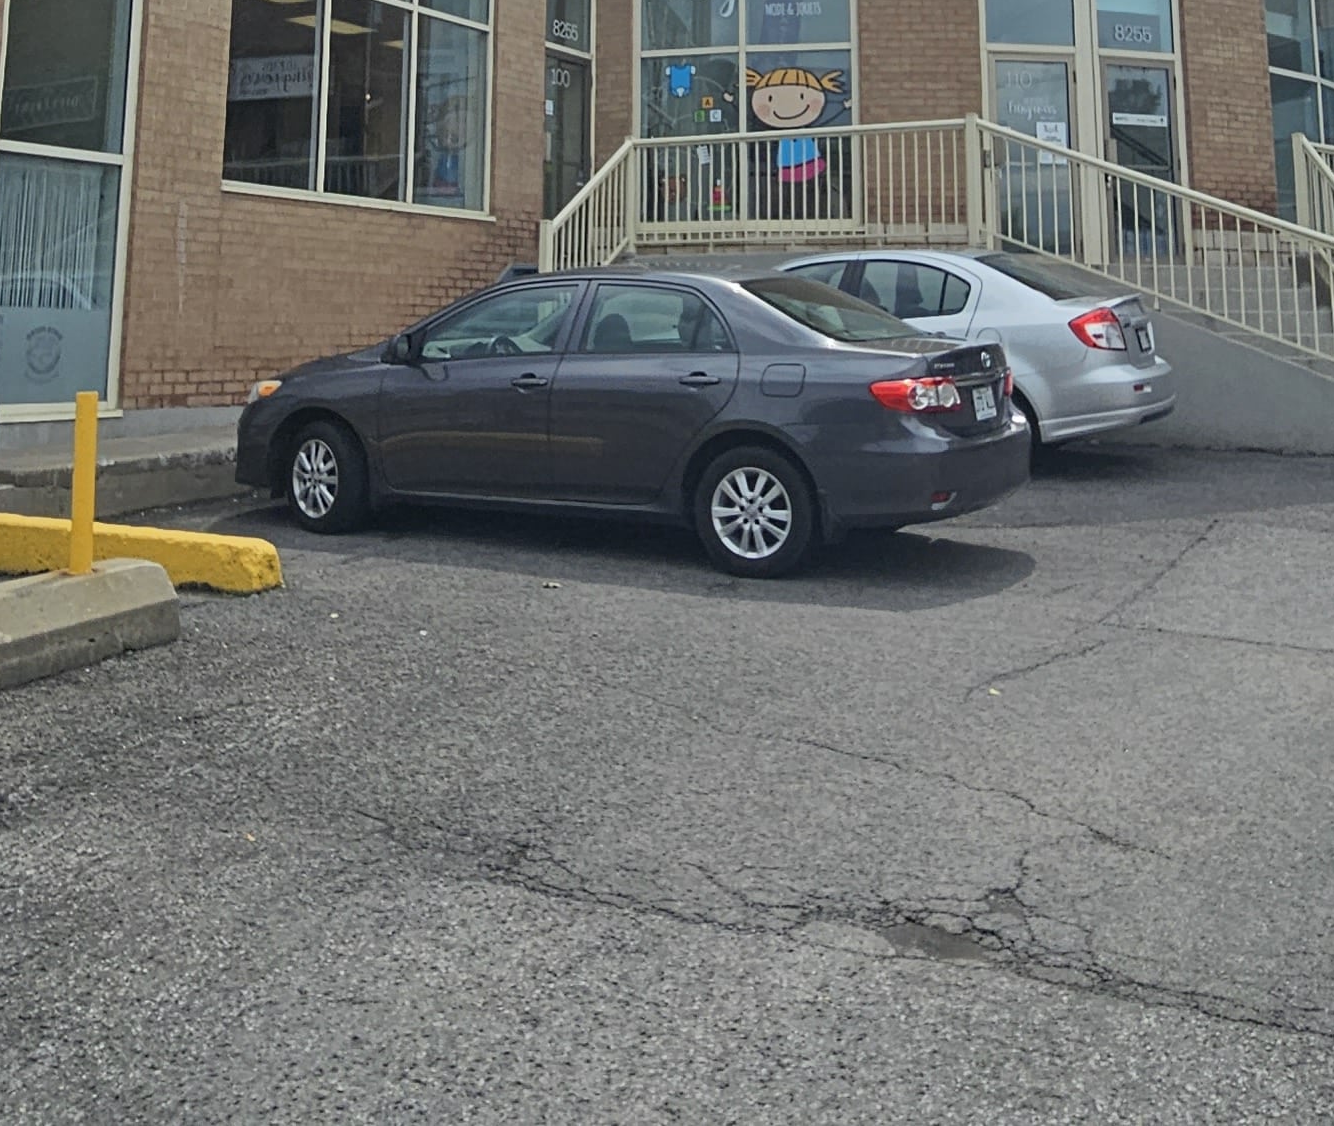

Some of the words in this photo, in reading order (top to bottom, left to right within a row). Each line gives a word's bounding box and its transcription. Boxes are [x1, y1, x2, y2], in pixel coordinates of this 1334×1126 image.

[553, 19, 579, 41] 8255
[1114, 24, 1152, 44] 8255
[551, 68, 570, 88] 100
